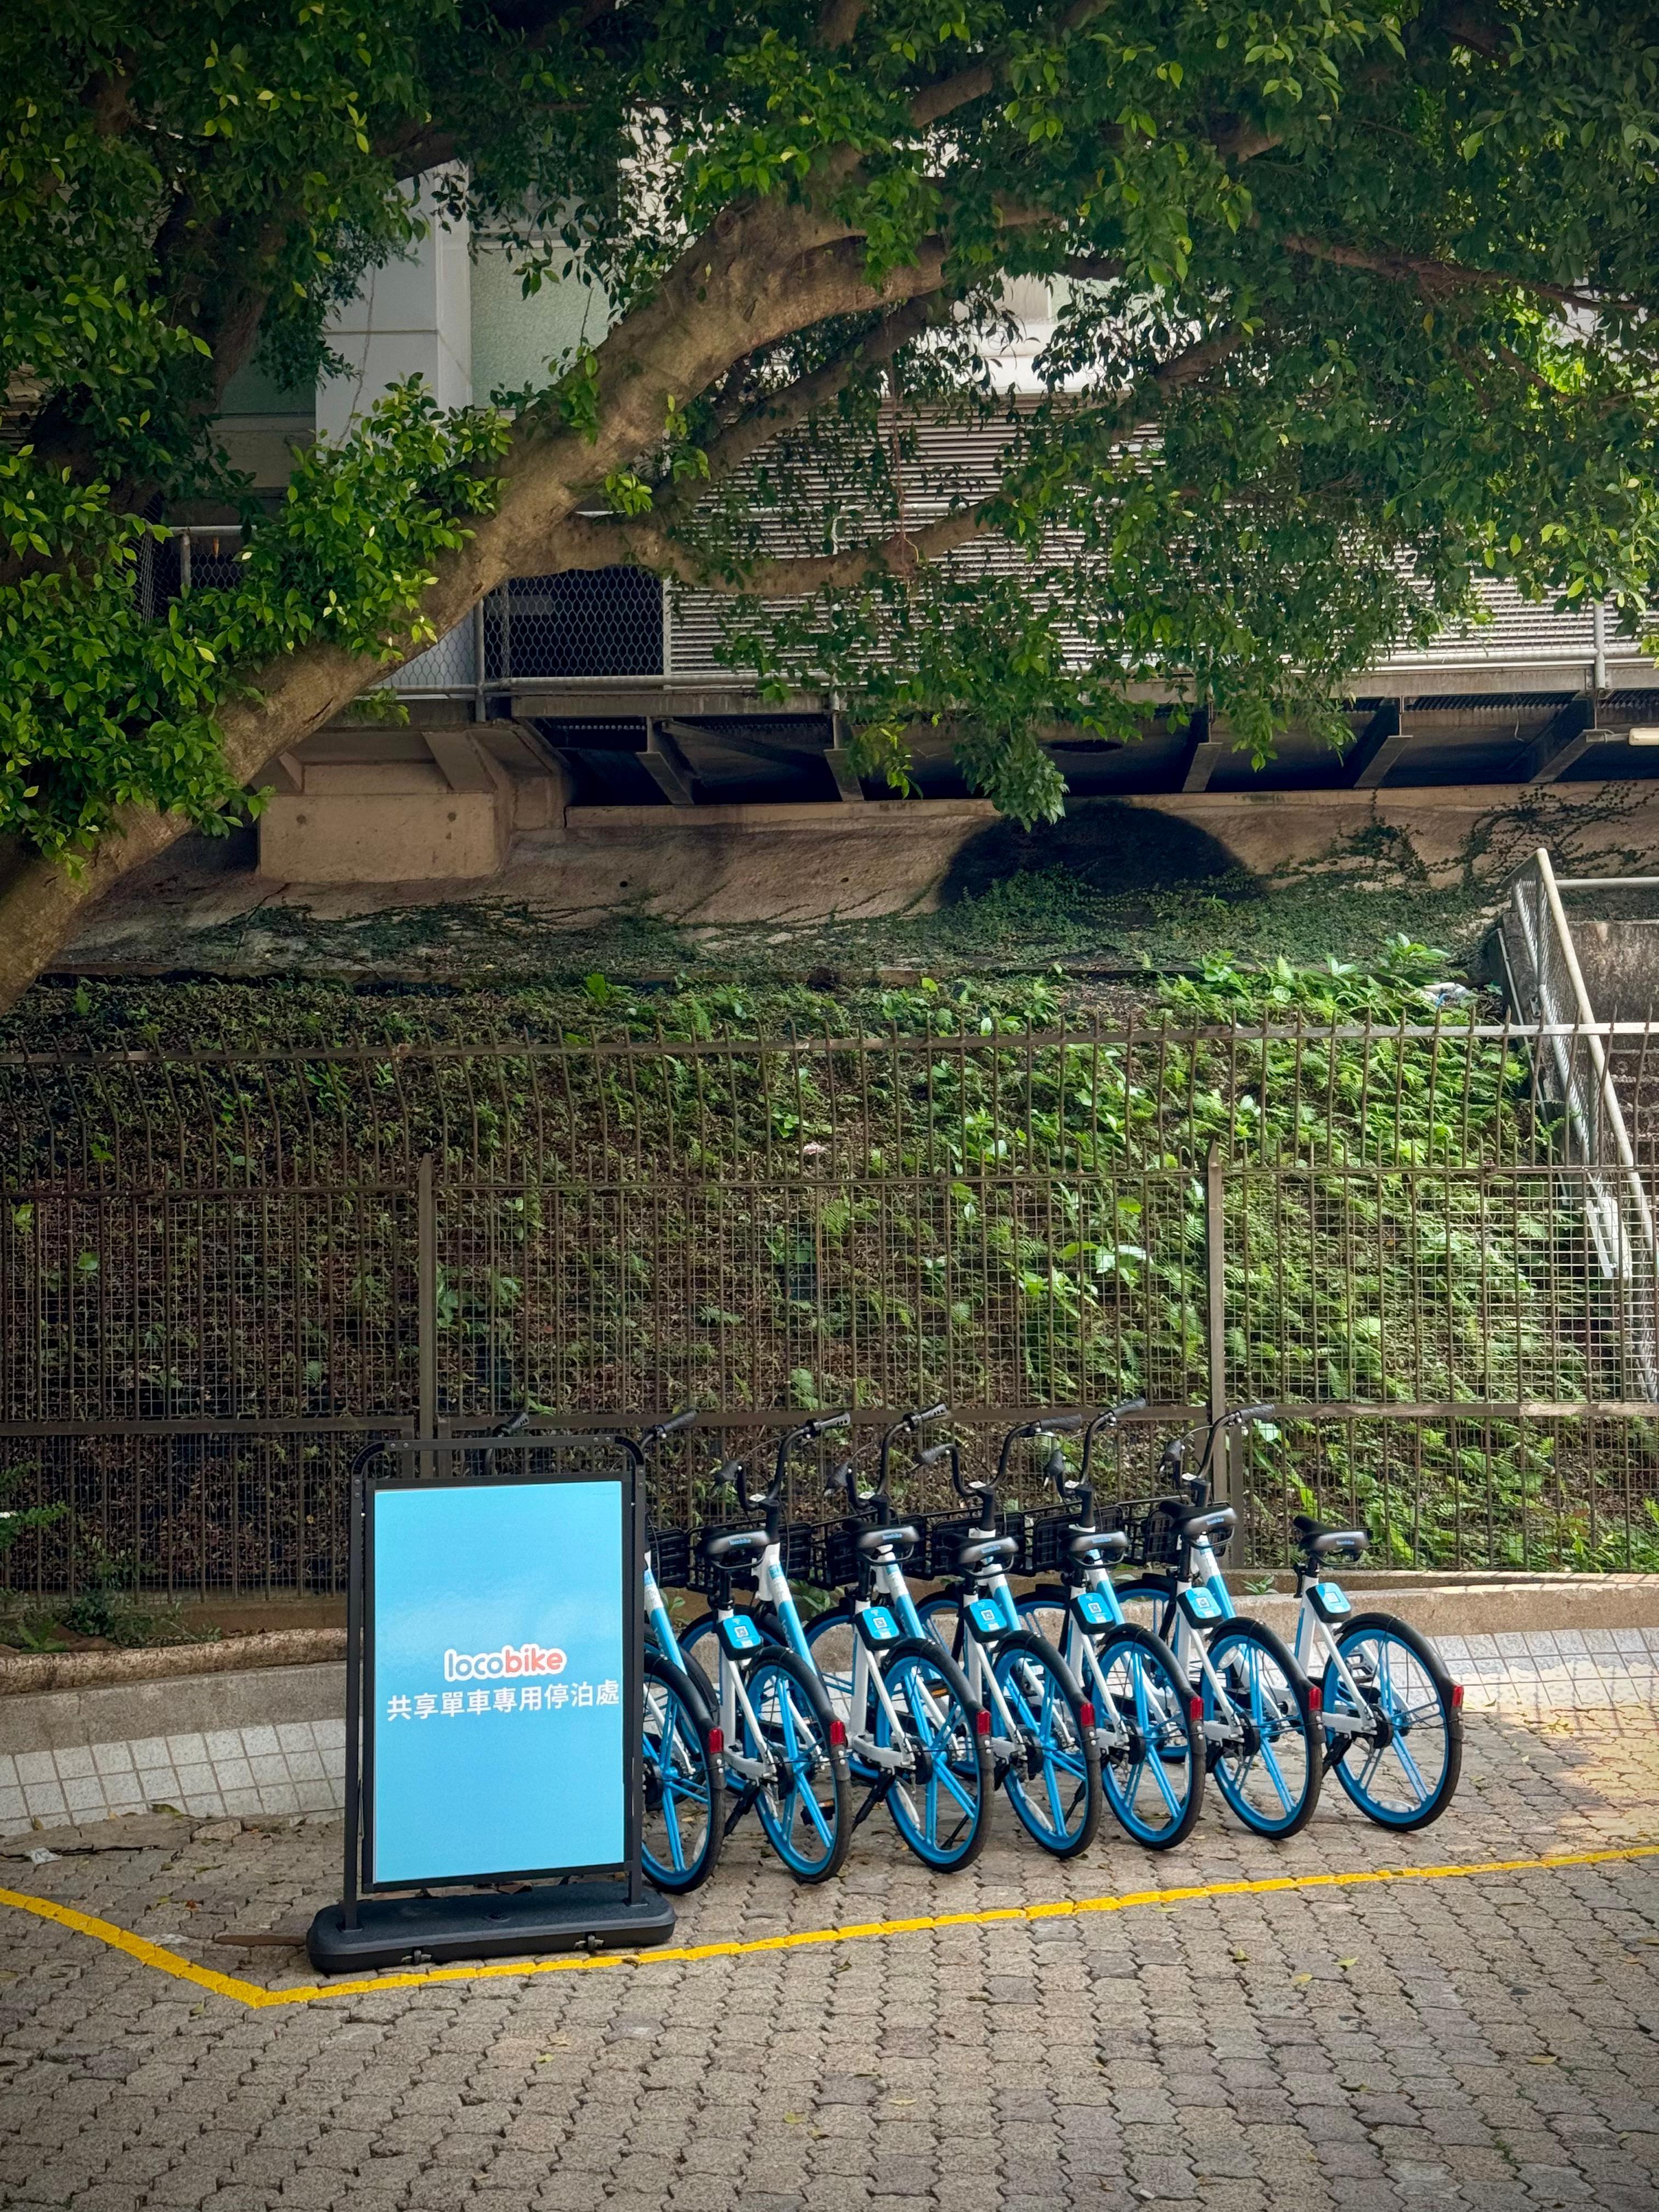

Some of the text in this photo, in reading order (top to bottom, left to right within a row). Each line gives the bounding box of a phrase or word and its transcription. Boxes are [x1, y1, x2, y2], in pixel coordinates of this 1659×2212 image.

[446, 1645, 566, 1680] locobike
[387, 1679, 620, 1722] 共享單車專用停泊處
